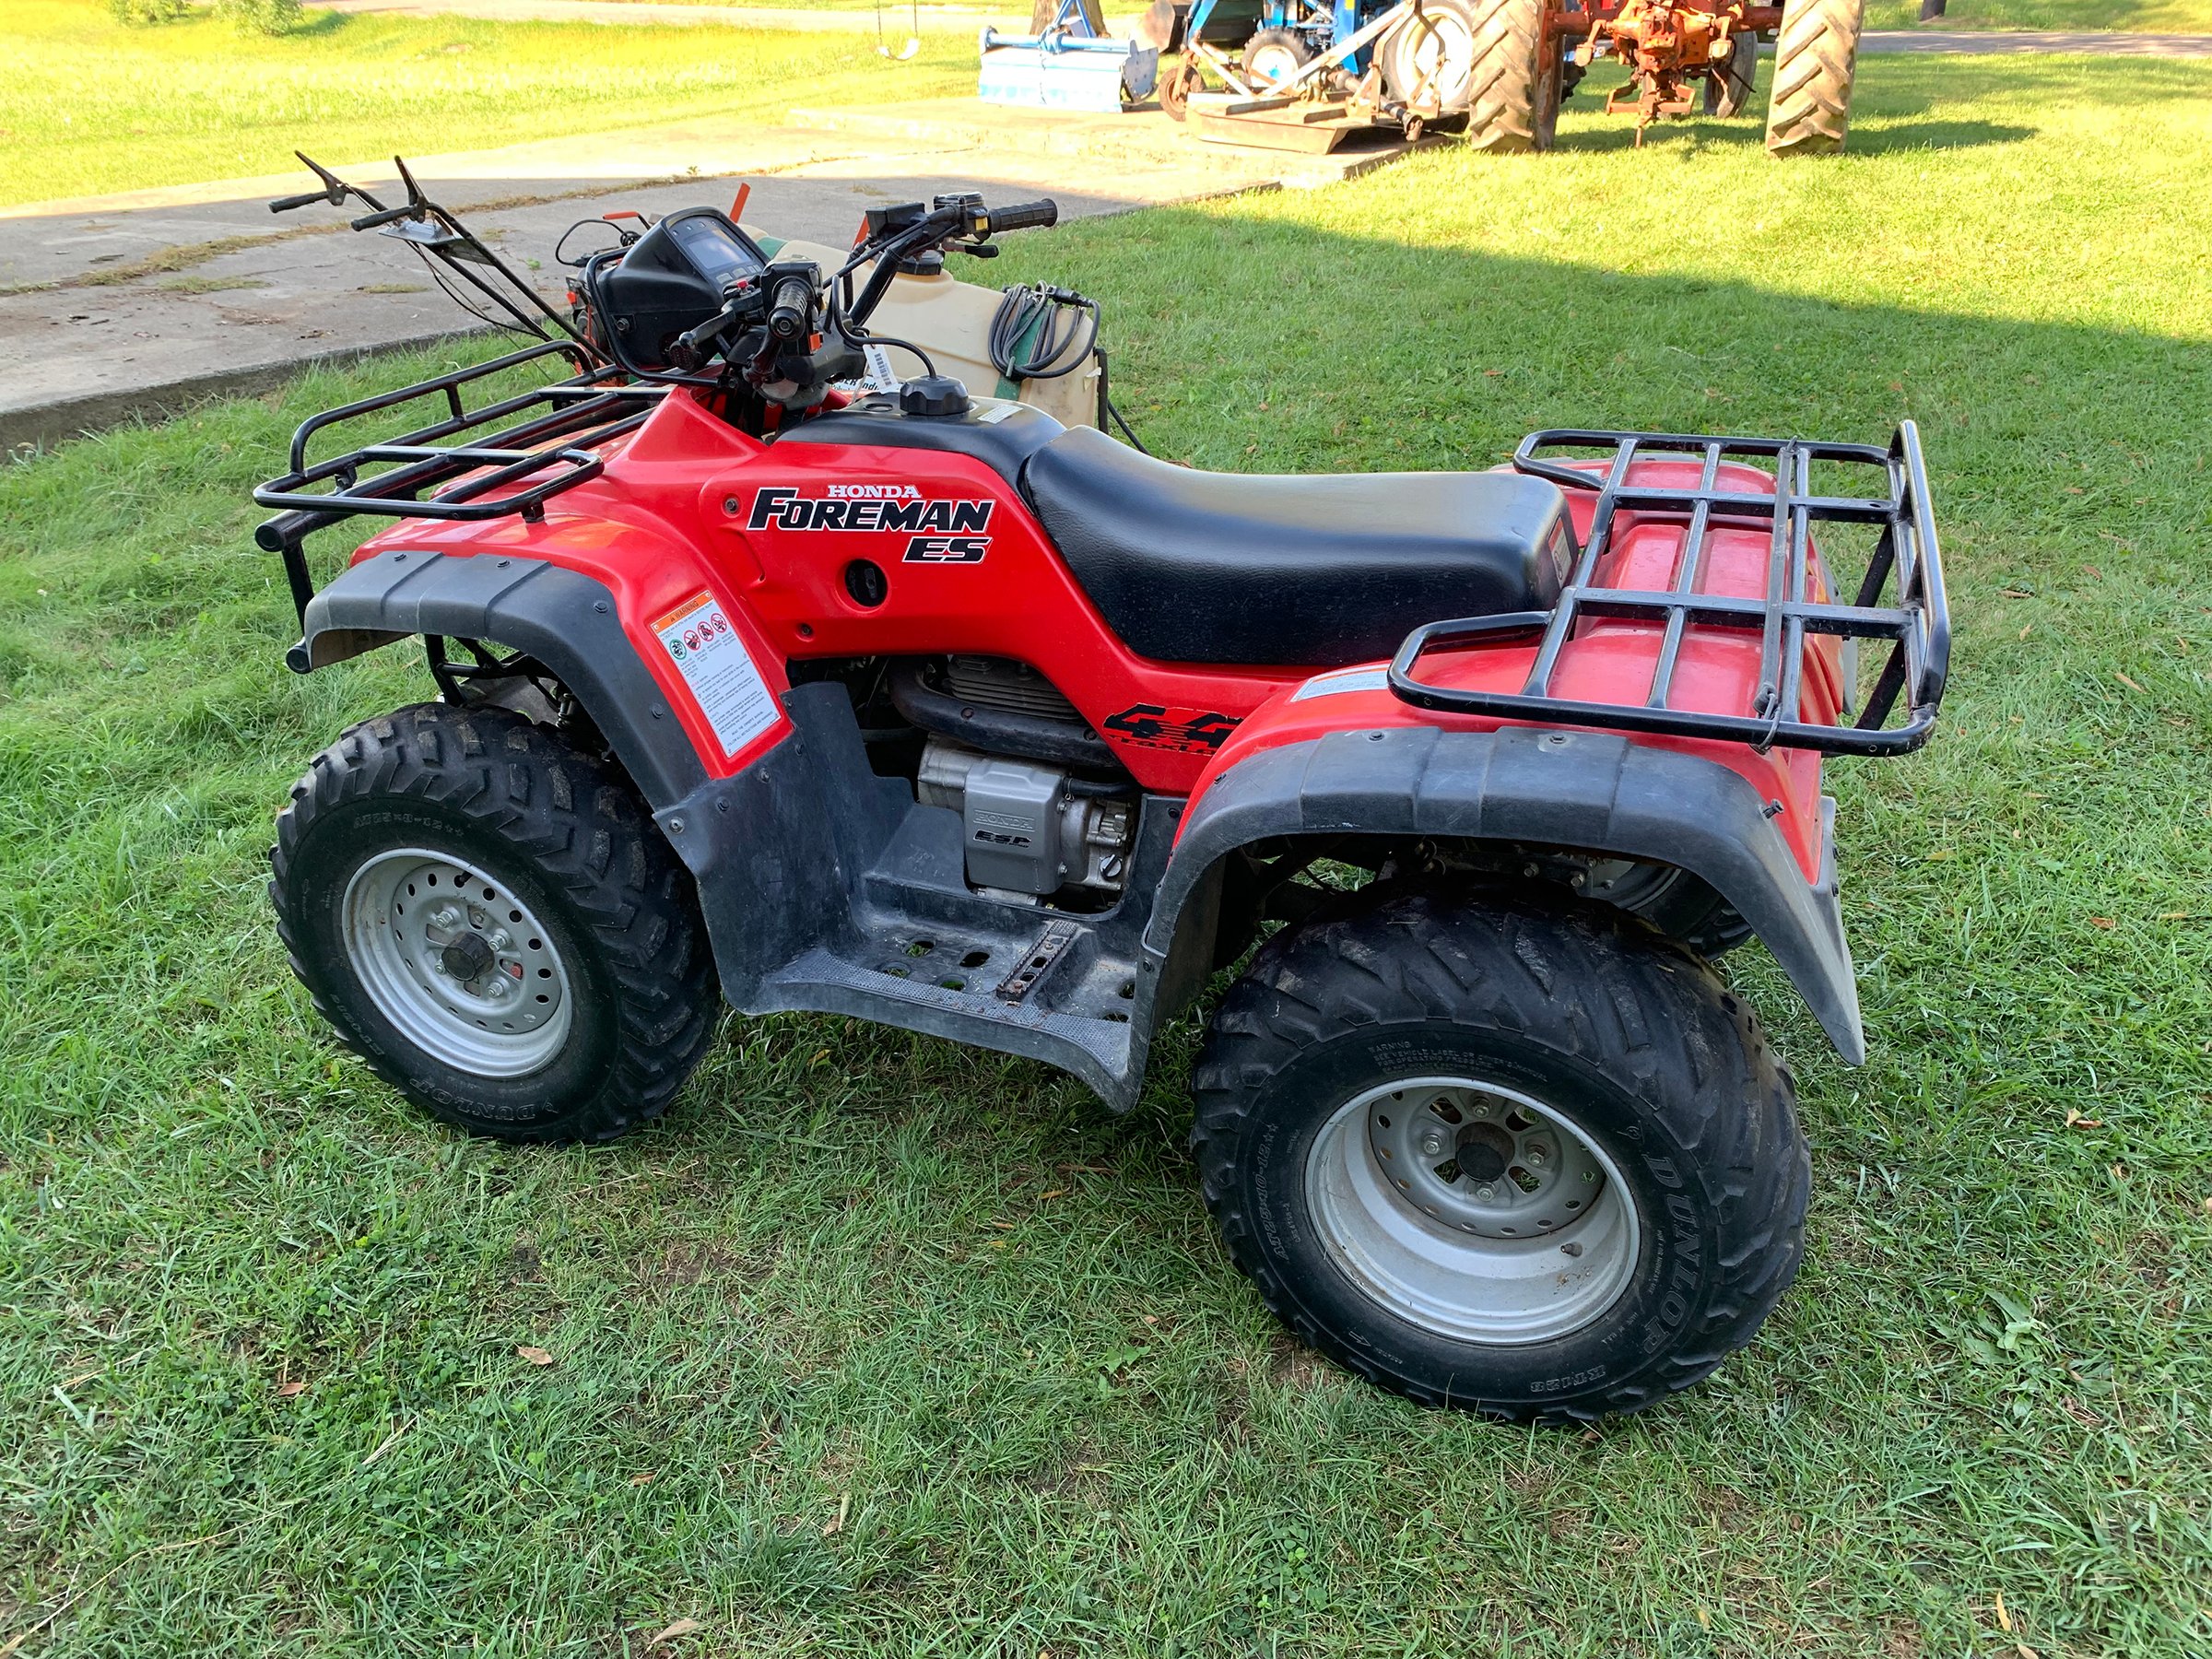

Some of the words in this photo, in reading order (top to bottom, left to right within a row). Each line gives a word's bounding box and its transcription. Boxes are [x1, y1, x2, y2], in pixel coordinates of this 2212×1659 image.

[828, 485, 922, 499] HONDA
[746, 487, 996, 533] FOREMAN
[901, 536, 994, 564] ES
[675, 600, 700, 619] WARNING
[975, 812, 1033, 830] HONDA
[973, 830, 1031, 844] ESP
[1368, 1041, 1411, 1053] WARNING
[1392, 1049, 1429, 1058] VEHICLE
[409, 1077, 536, 1122] DUNLOP
[1641, 1153, 1701, 1355] DUNLOP
